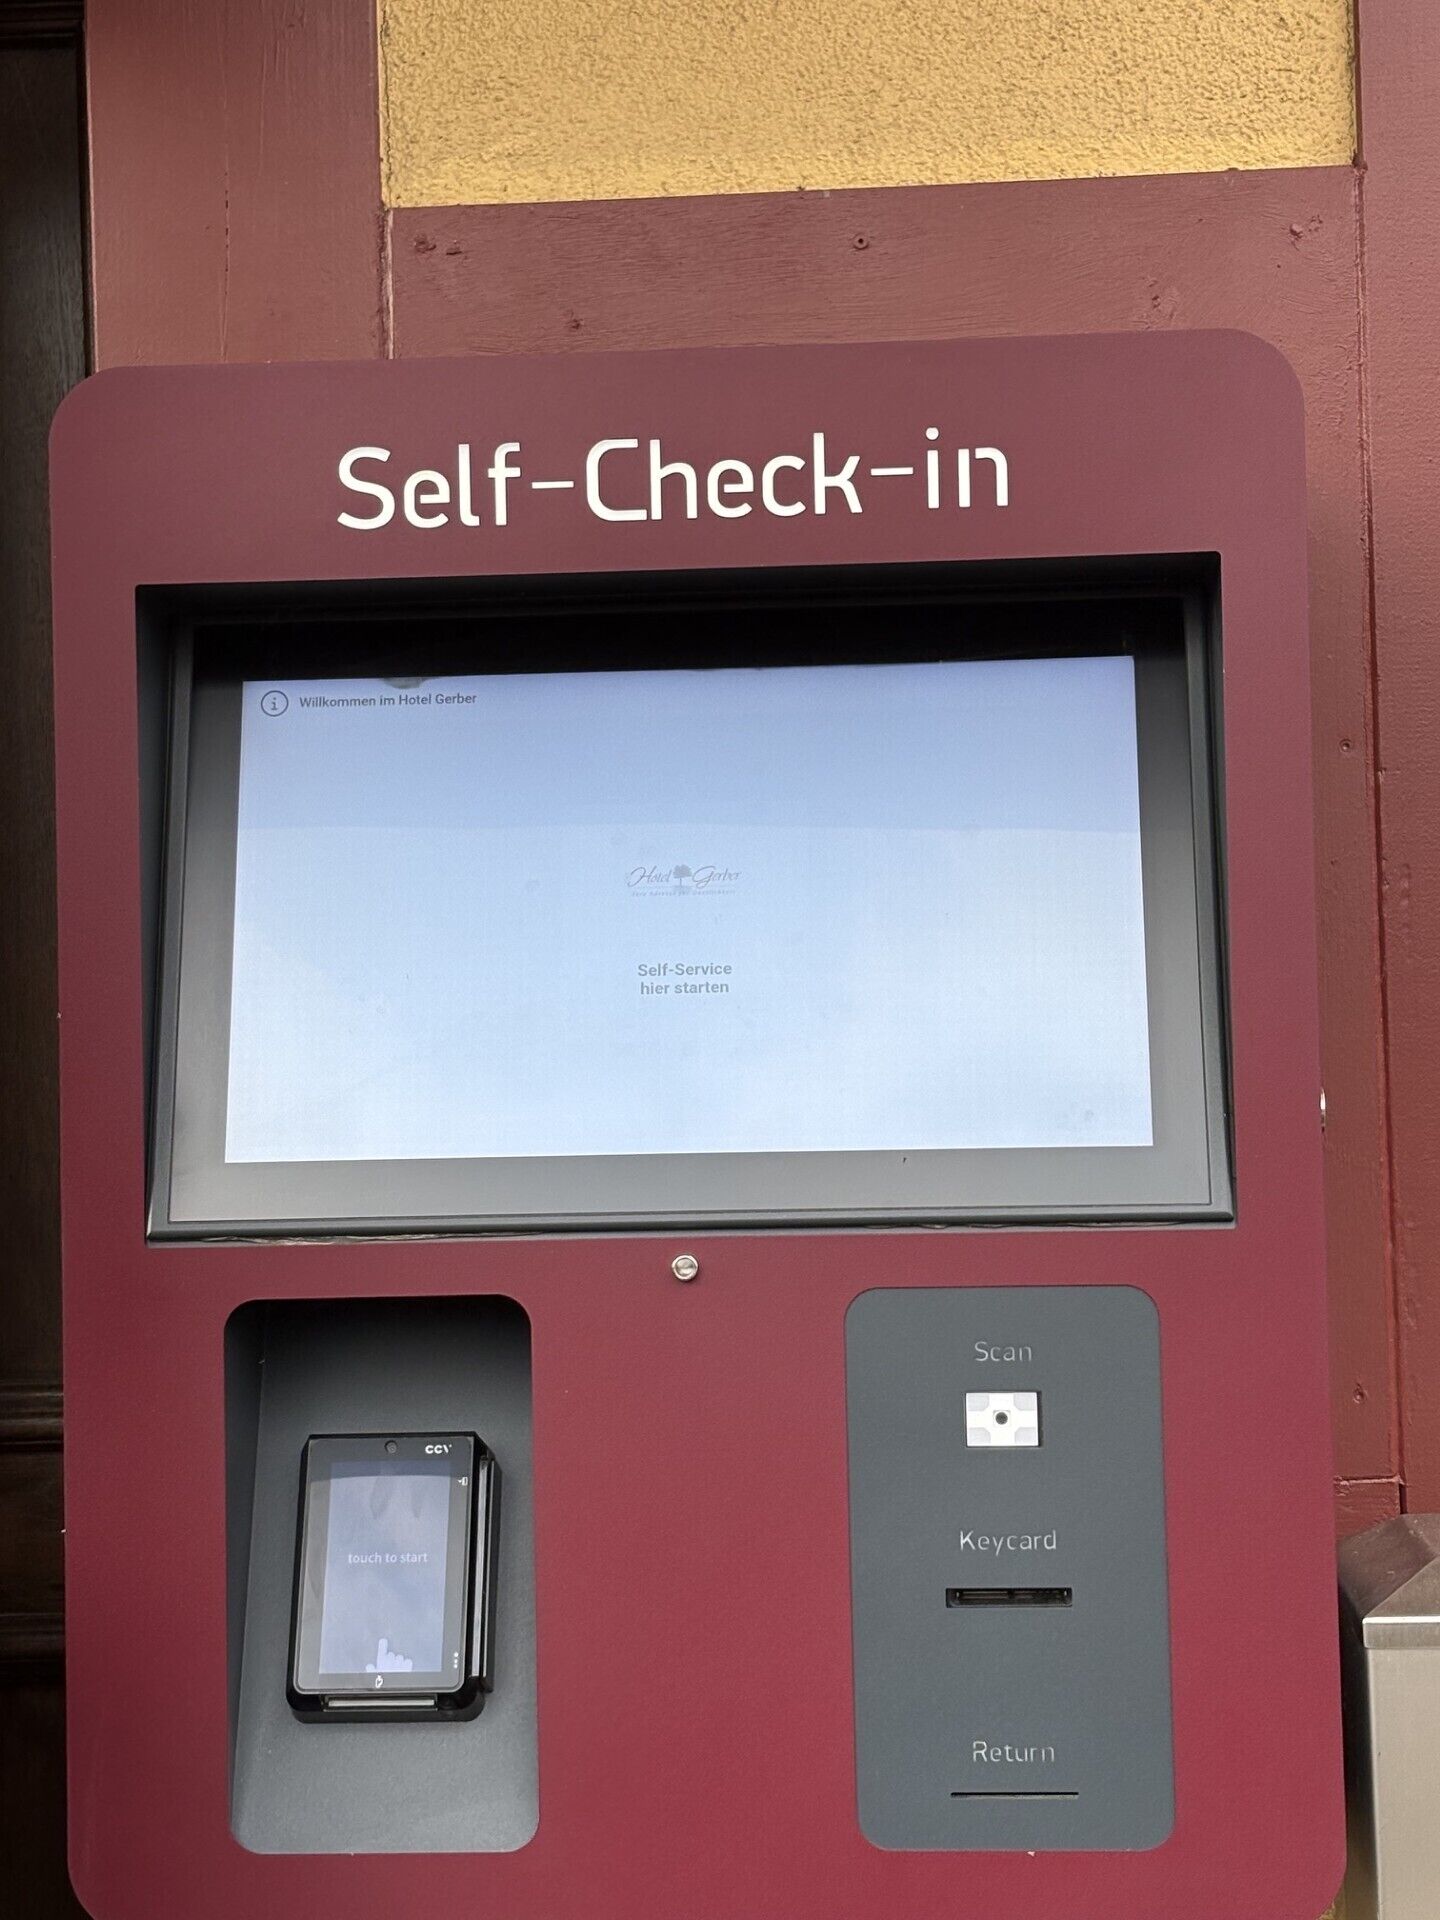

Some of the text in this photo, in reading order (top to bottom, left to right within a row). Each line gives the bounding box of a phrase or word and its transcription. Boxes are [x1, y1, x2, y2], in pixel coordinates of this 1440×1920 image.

[336, 426, 1010, 531] Self-Check-in
[299, 692, 477, 708] Willkommen im Hotel Gerber
[637, 962, 733, 977] Self-Service
[640, 981, 730, 995] hier starten
[974, 1340, 1033, 1363] Scan
[959, 1529, 1057, 1556] Keycard
[347, 1552, 428, 1564] touch to start
[972, 1740, 1055, 1763] Return
